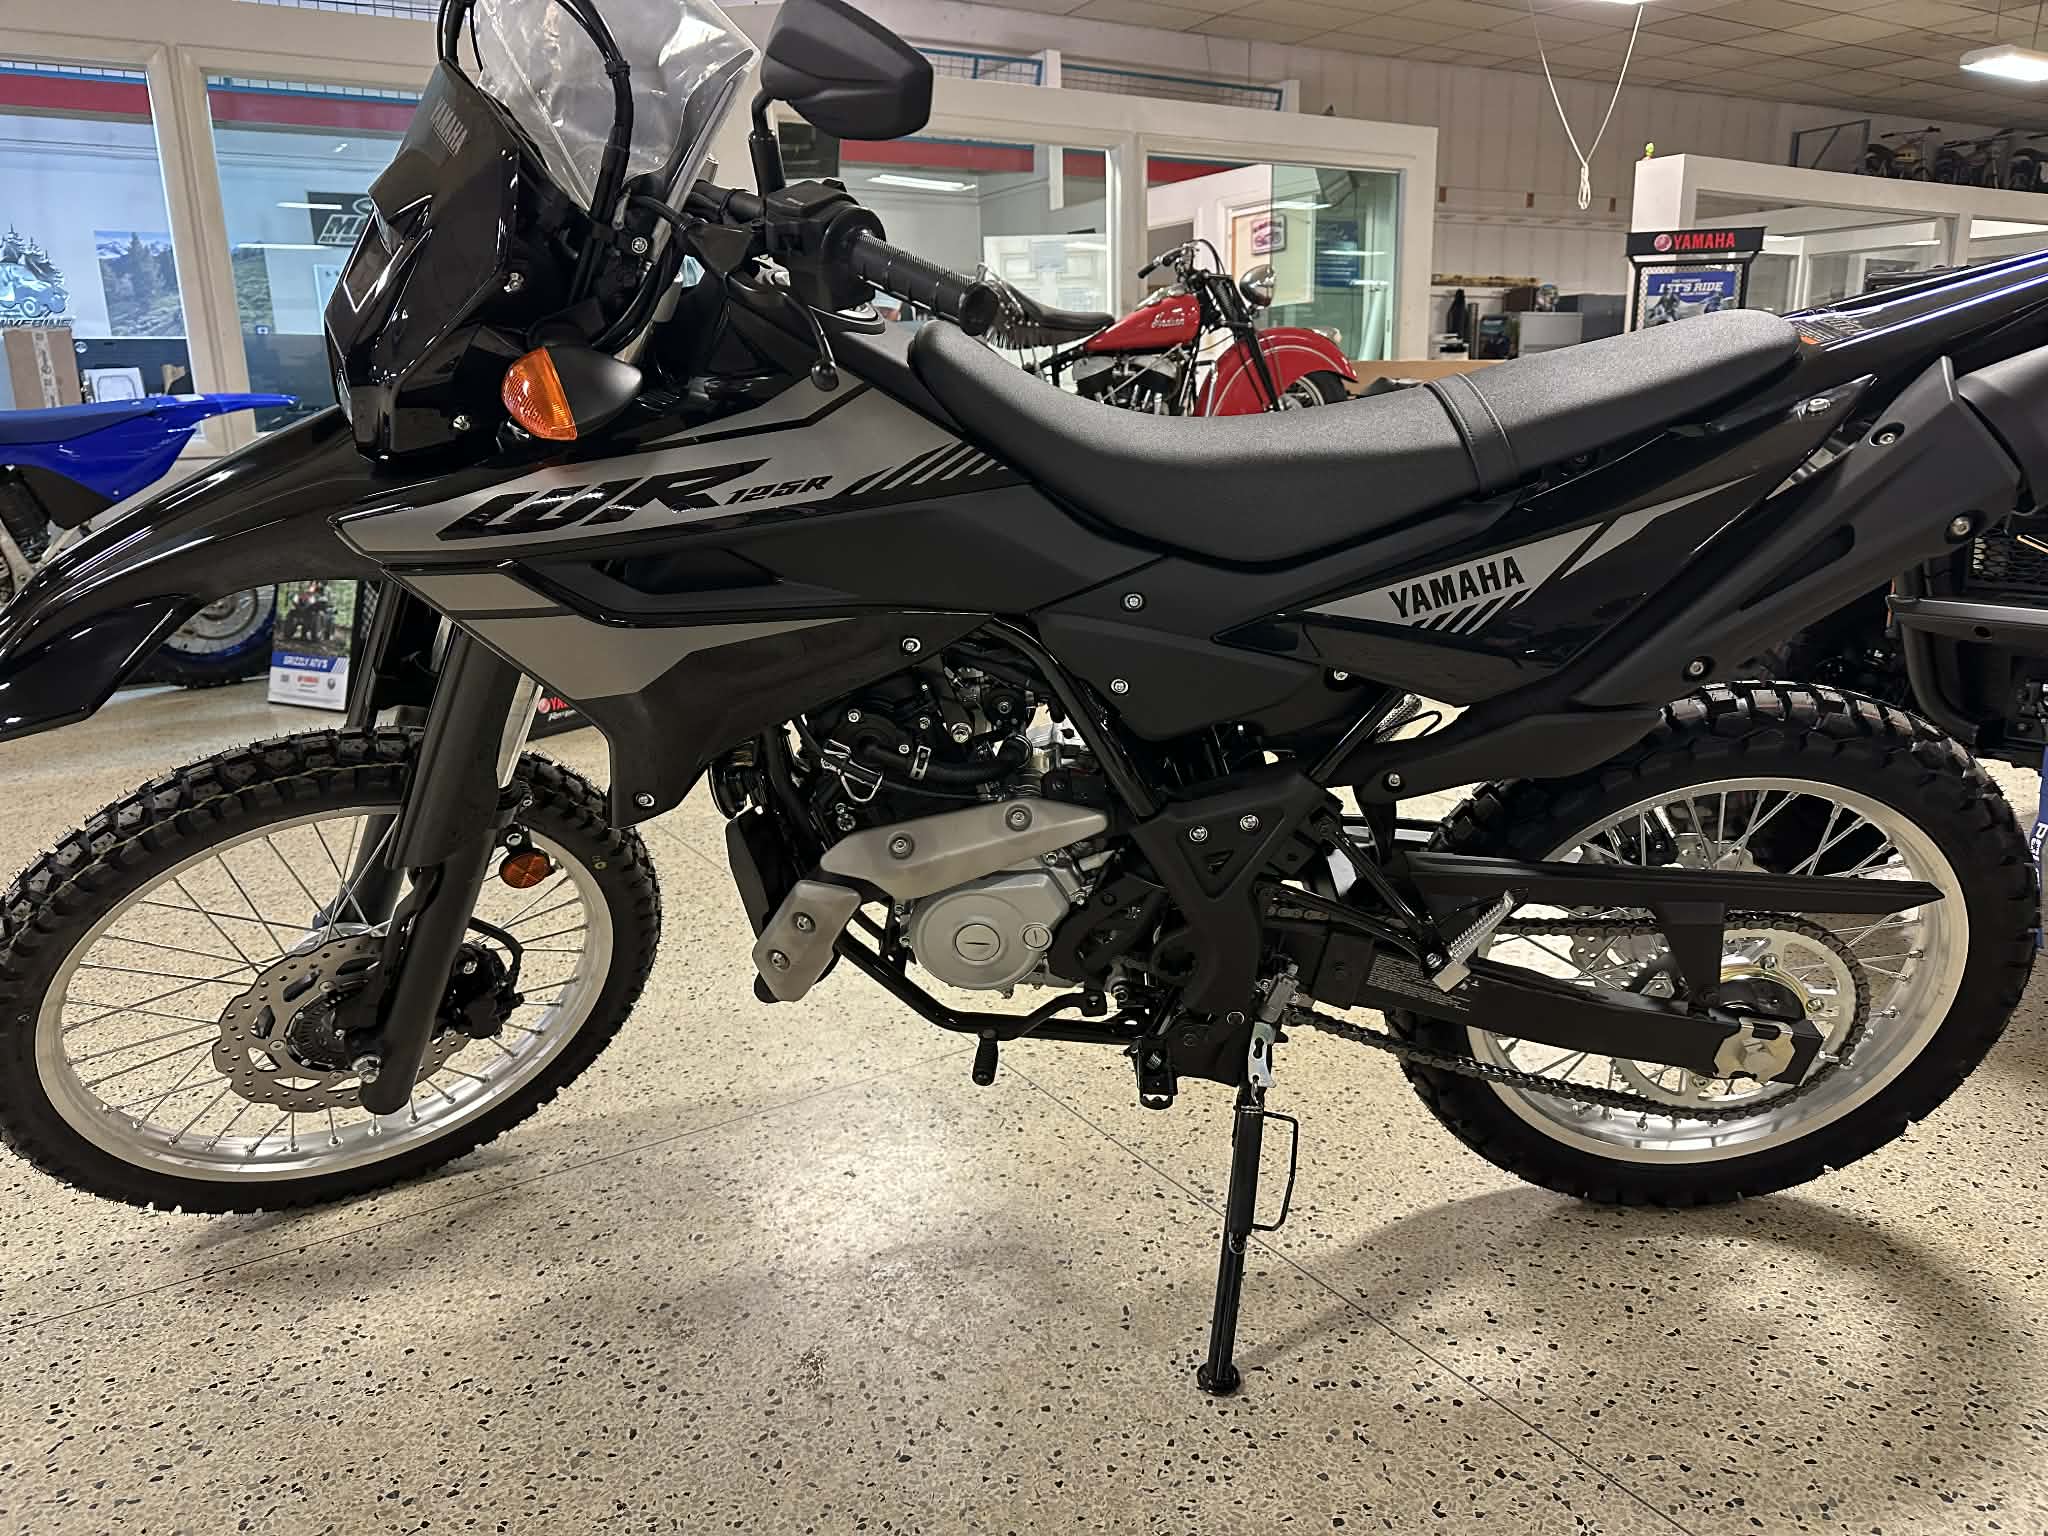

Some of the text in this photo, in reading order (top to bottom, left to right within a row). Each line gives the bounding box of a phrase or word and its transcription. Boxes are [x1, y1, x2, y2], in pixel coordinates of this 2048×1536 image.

[430, 96, 468, 155] YAMAHA
[1673, 232, 1735, 251] YAMAHA
[1693, 281, 1724, 292] RIDE
[1388, 555, 1525, 619] YAMAHA
